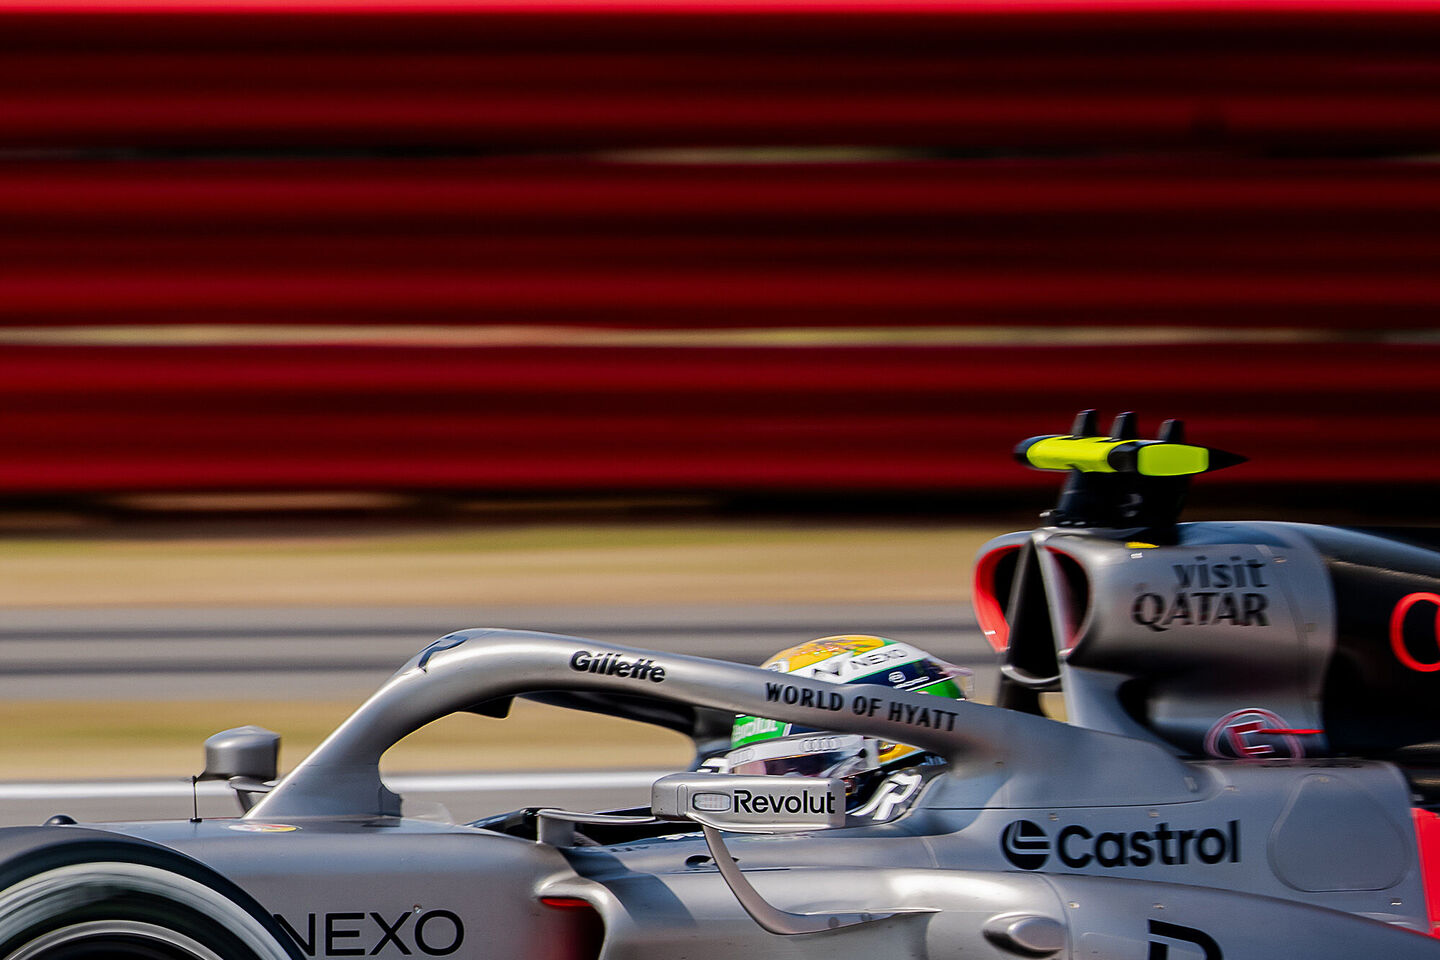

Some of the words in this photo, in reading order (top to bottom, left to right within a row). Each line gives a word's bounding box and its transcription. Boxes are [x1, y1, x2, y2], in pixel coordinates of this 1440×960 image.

[1172, 556, 1270, 589] visit
[1131, 592, 1271, 631] QATAR
[570, 651, 666, 683] Gillette
[765, 682, 844, 711] WORLD
[852, 695, 882, 717] OF
[887, 701, 959, 731] HYATT
[733, 790, 836, 814] Revolut
[1057, 819, 1241, 868] Castrol
[272, 909, 464, 956] NEXO
